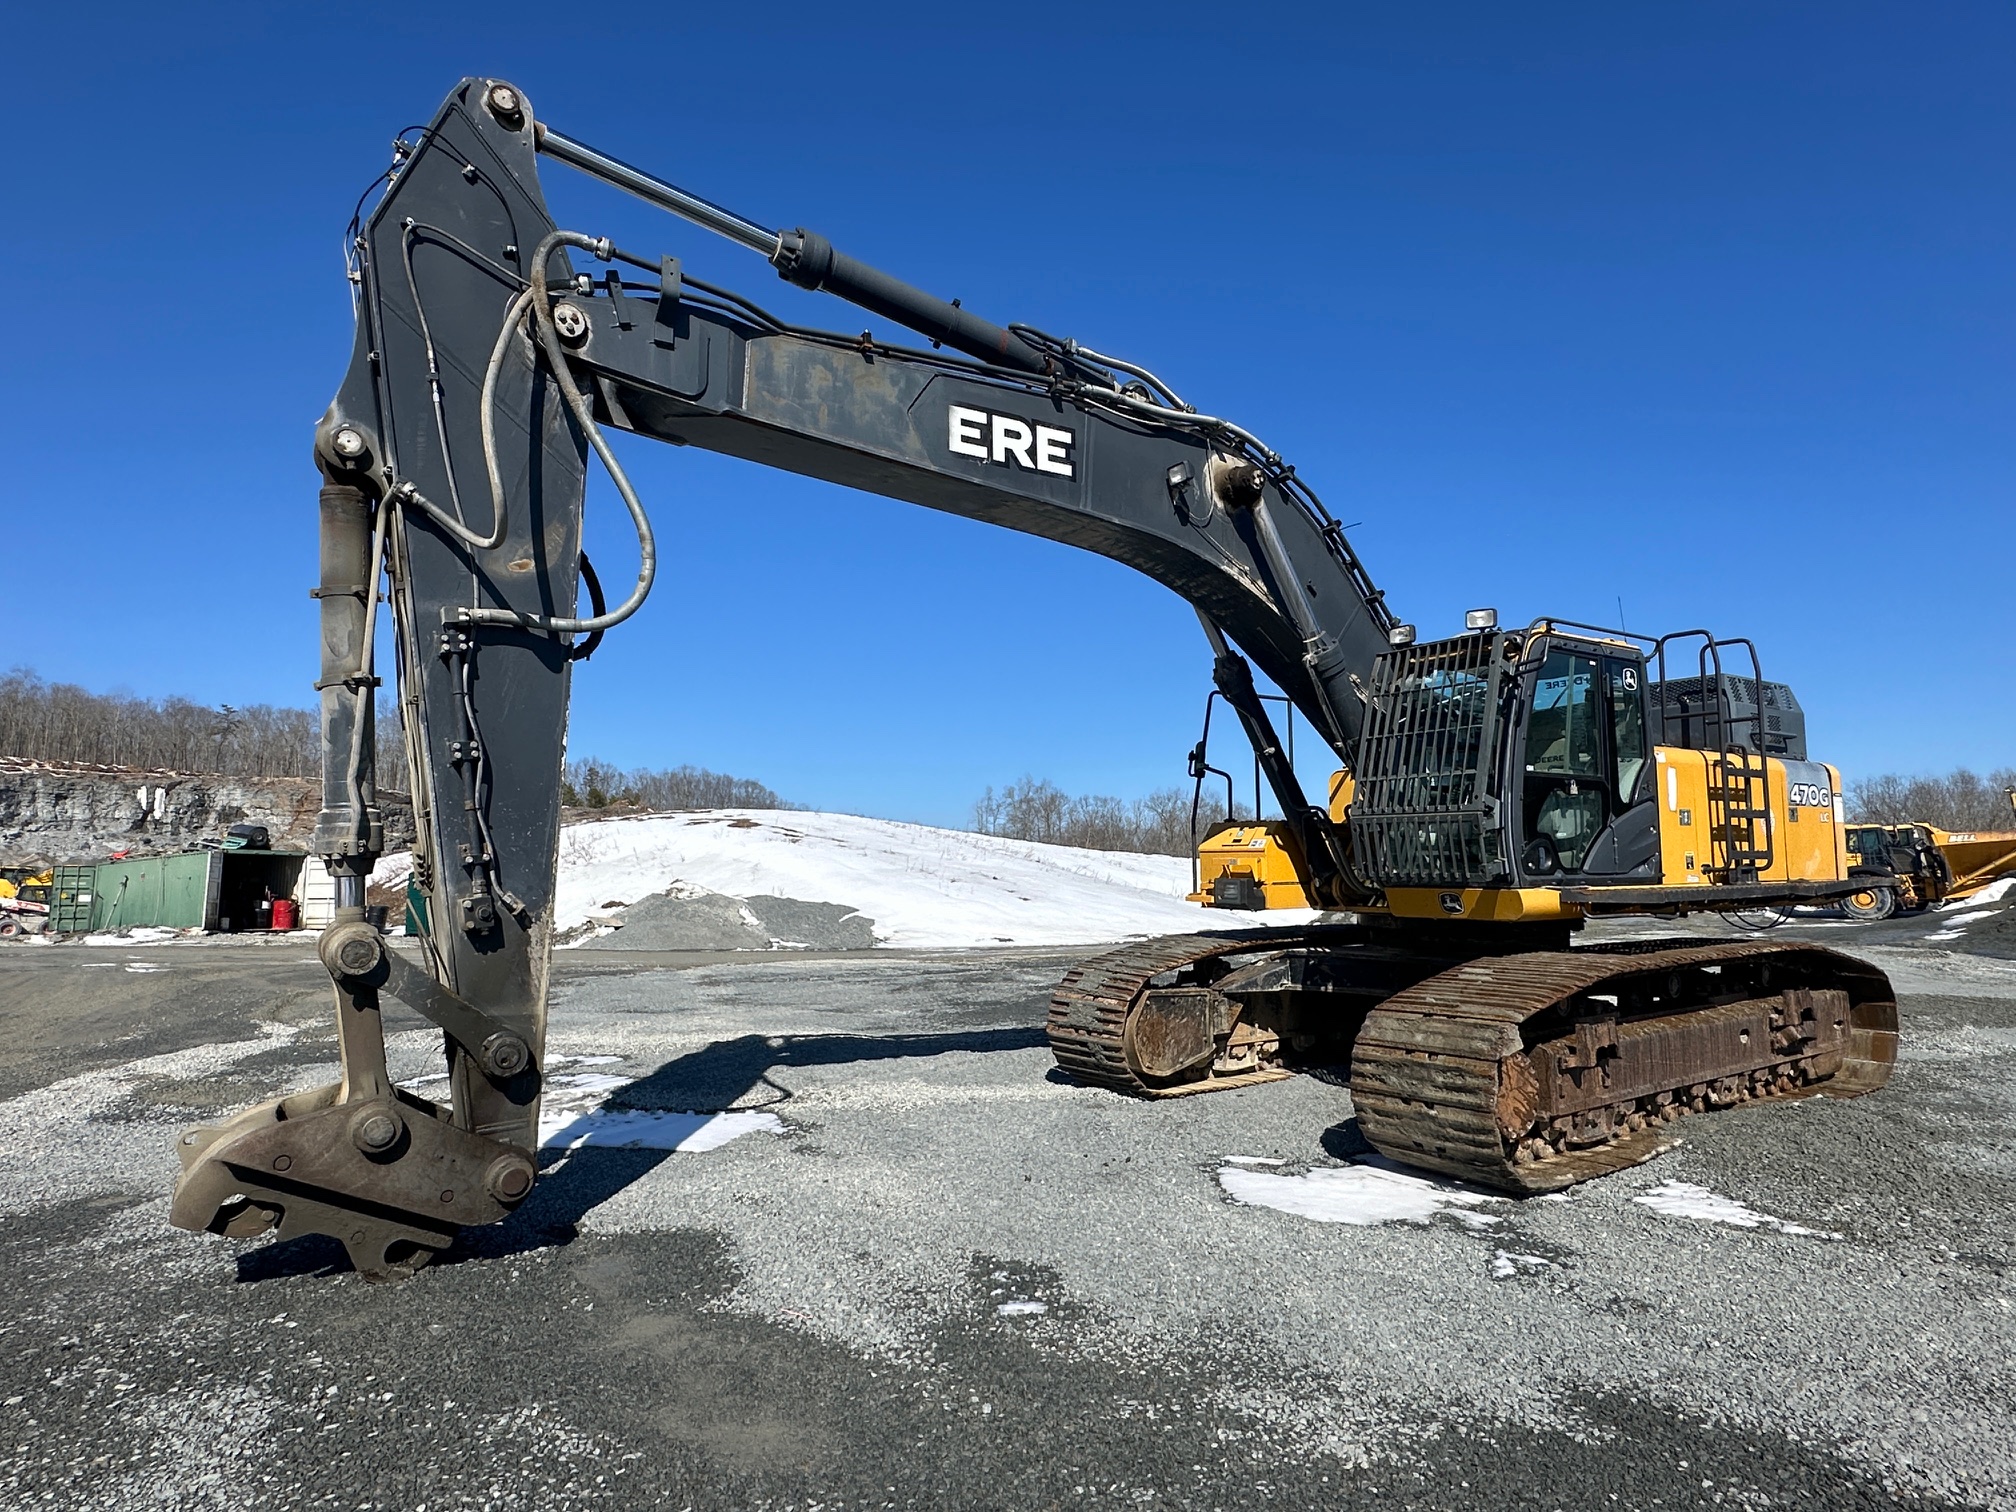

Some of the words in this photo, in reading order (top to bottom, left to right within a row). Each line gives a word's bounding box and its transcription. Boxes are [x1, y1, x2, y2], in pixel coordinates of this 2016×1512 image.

[948, 404, 1074, 478] ERE
[1790, 783, 1830, 807] 470G
[1820, 812, 1830, 823] LC
